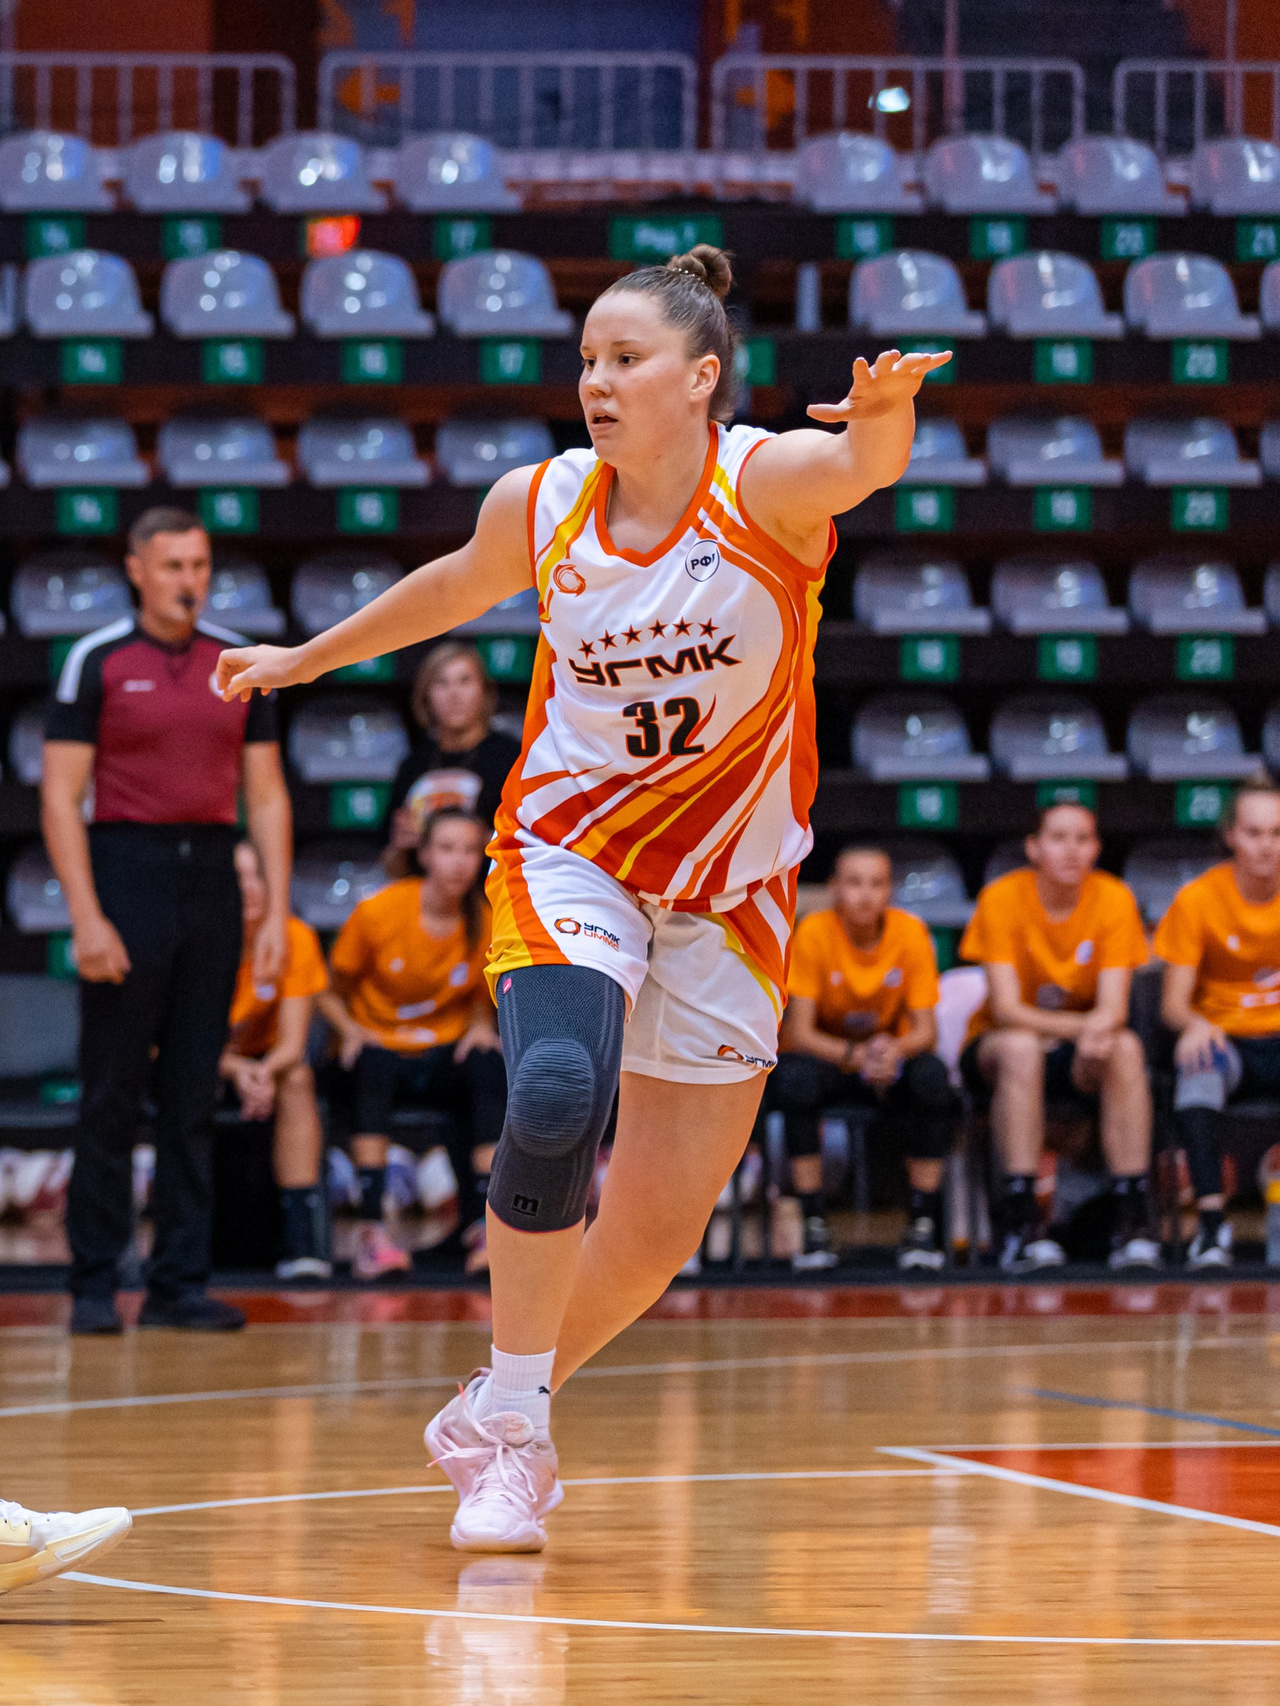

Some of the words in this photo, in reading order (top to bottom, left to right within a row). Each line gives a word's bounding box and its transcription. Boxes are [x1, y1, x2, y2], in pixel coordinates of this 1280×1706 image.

[567, 634, 743, 688] УГМК
[621, 696, 706, 759] 32
[583, 922, 621, 946] УГМК
